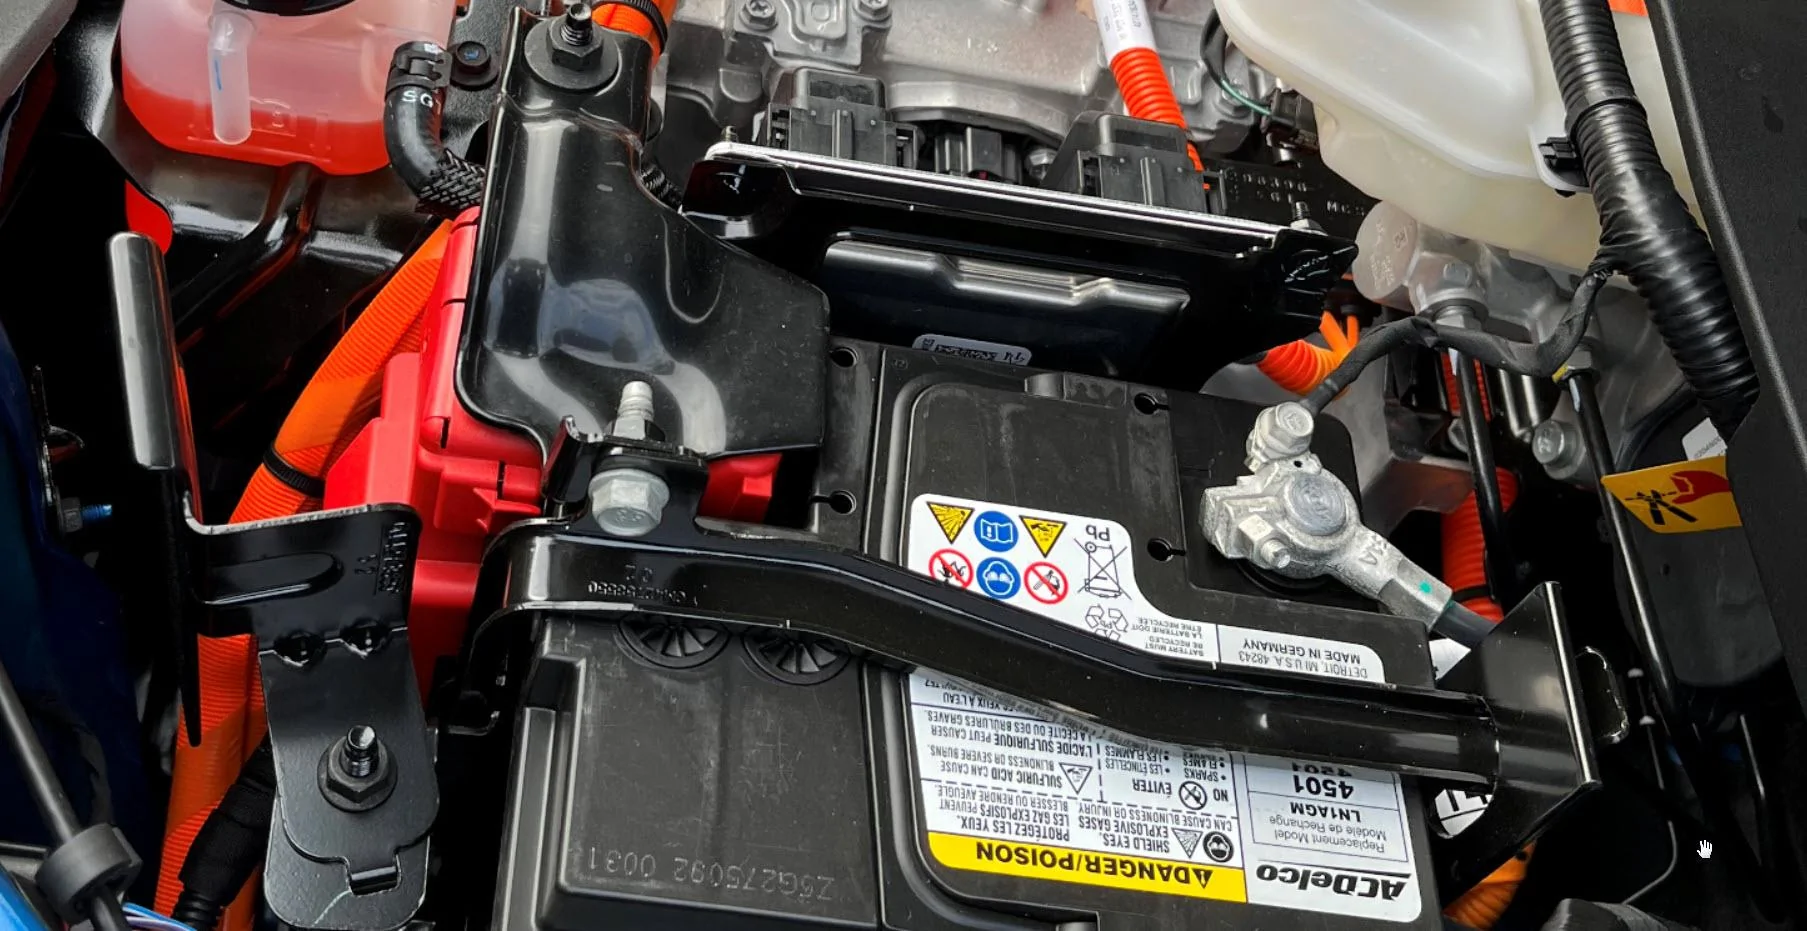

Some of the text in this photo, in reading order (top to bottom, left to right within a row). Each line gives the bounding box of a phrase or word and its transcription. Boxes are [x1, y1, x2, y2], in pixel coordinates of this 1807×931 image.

[1086, 524, 1110, 542] Pb
[1130, 624, 1150, 632] DOIT
[1152, 627, 1190, 638] BATTERIE
[1145, 642, 1204, 656] BATTERY MUST
[1149, 636, 1190, 647] RECYCLED
[1238, 651, 1269, 665] 48243
[1242, 638, 1360, 664] MADE IN GERMANY
[1306, 661, 1318, 672] MI
[1321, 662, 1367, 678] DETROIT,
[943, 692, 966, 704] L'EAU
[965, 715, 1011, 732] BRÛLURES
[1014, 722, 1030, 734] DES
[1033, 724, 1045, 736] OU
[931, 726, 1092, 758] L'ACIDE SULFURIQUE PEUT CAUSER
[928, 744, 1054, 771] BLINDNESS OR SEVERE BURNS.
[1105, 746, 1144, 760] FLAMMES
[941, 761, 1062, 788] SULFURIC ACID CAN CAUSE
[1106, 758, 1162, 776] LES ÉTINCELLES
[1184, 768, 1218, 782] SPARKS
[1132, 778, 1172, 798] ÉVITER
[1213, 789, 1228, 802] NO
[1292, 774, 1354, 800] 4501
[934, 785, 1068, 812] BLESSER OU RENDRE AVEUGLE.
[939, 799, 1069, 826] LES GAZ EXPLOSIFS PEUVENT
[1114, 807, 1126, 818] OR
[1130, 808, 1179, 825] BLINDNESS
[1290, 802, 1361, 822] LN1AGM
[957, 816, 1069, 842] PROTÉGEZ LES YEUX.
[1078, 816, 1168, 838] EXPLOSIVE GASES
[1183, 816, 1211, 829] CAUSE
[1214, 820, 1232, 831] CAN
[1270, 815, 1386, 841] Modèle de Rechange
[1099, 832, 1170, 853] SHIELD EYES.
[1274, 830, 1384, 853] Replacement Model
[976, 844, 1190, 884] DANGER/POISON
[1256, 864, 1407, 901] ACDelco
